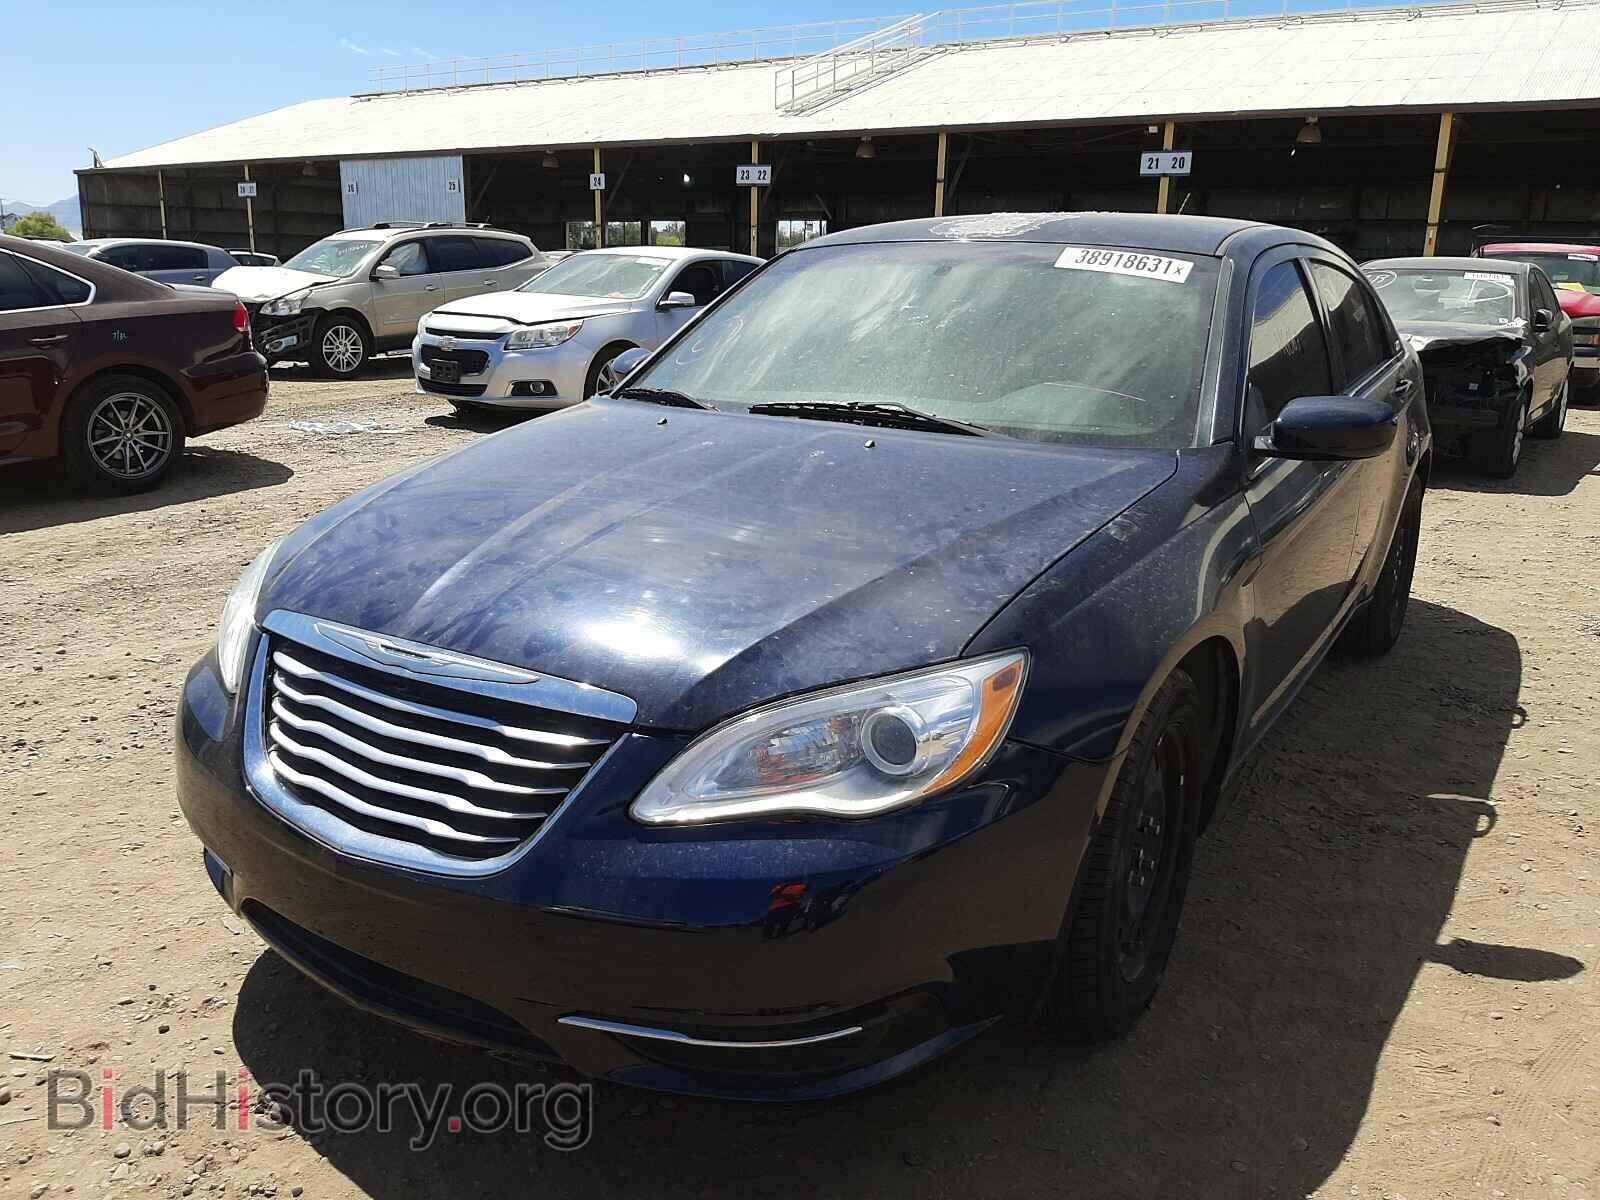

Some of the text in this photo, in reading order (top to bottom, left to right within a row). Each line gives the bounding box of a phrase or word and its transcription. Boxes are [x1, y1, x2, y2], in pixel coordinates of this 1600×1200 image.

[1147, 156, 1185, 170] 21 20
[740, 169, 767, 181] 23 22
[593, 176, 601, 187] 24
